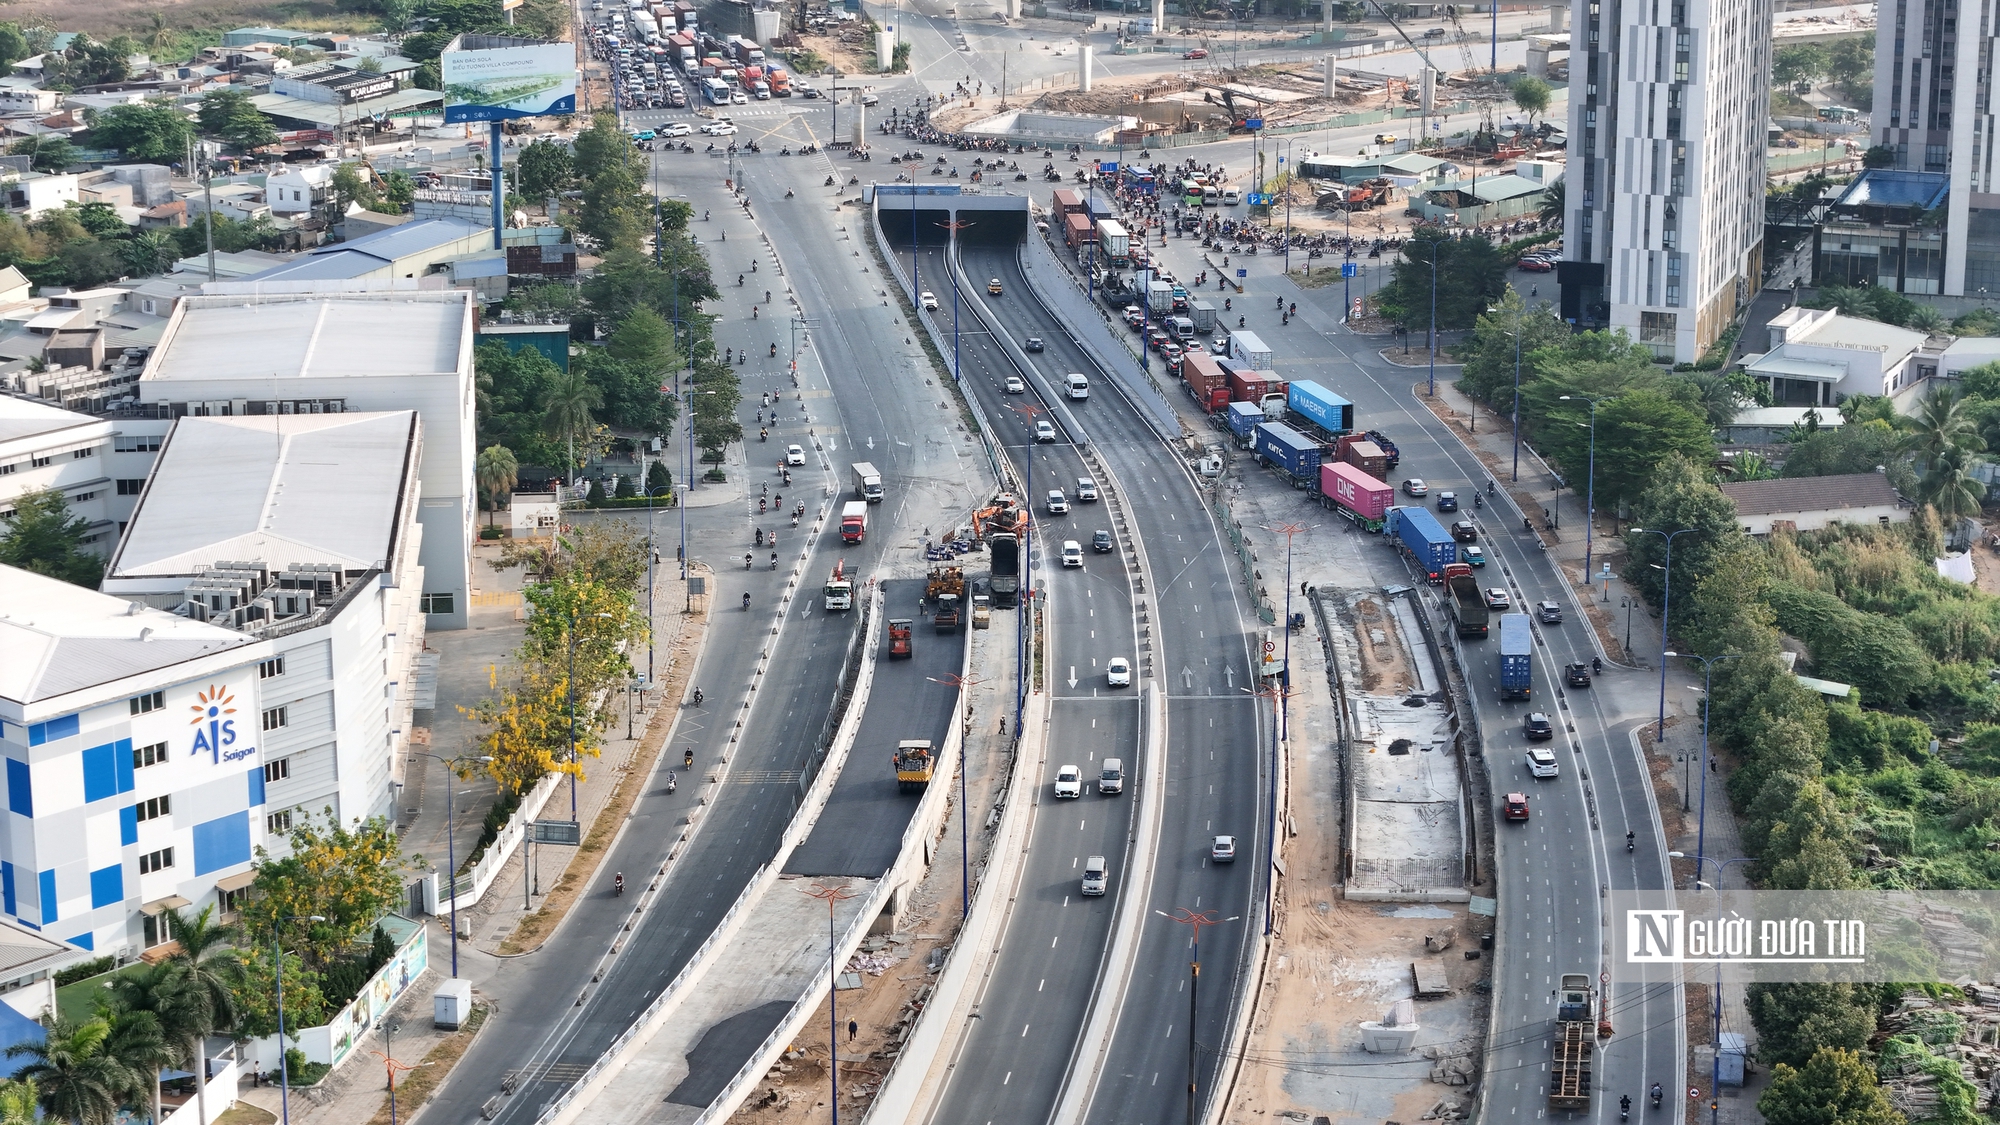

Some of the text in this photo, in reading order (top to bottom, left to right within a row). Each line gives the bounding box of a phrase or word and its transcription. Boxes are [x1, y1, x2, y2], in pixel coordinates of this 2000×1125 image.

[502, 59, 534, 67] COMPOUND
[366, 80, 394, 94] LIMOUSINE
[1300, 395, 1327, 419] MAERSK
[1337, 477, 1355, 501] ONE
[223, 746, 256, 762] Saigon
